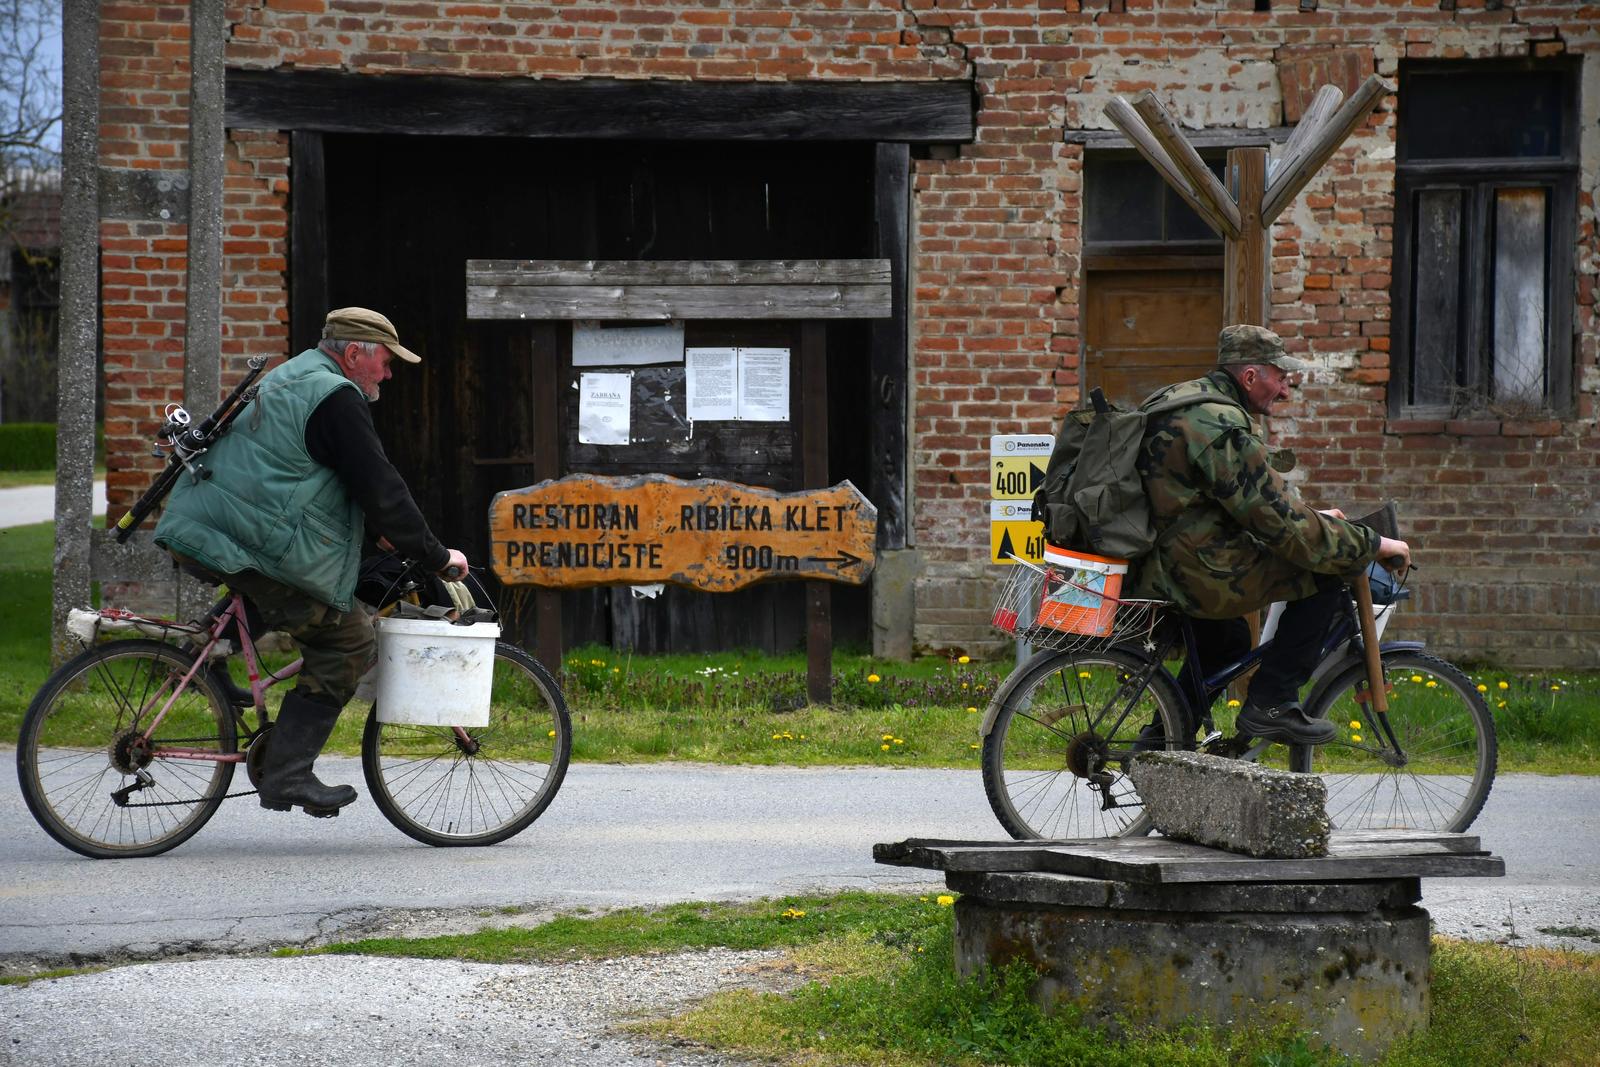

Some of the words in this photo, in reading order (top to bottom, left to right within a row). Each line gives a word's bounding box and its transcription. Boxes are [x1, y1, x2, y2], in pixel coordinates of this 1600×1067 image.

[996, 471, 1027, 495] 400
[513, 503, 638, 530] RESTORAN
[506, 532, 663, 569] PRENOĆIŠTE
